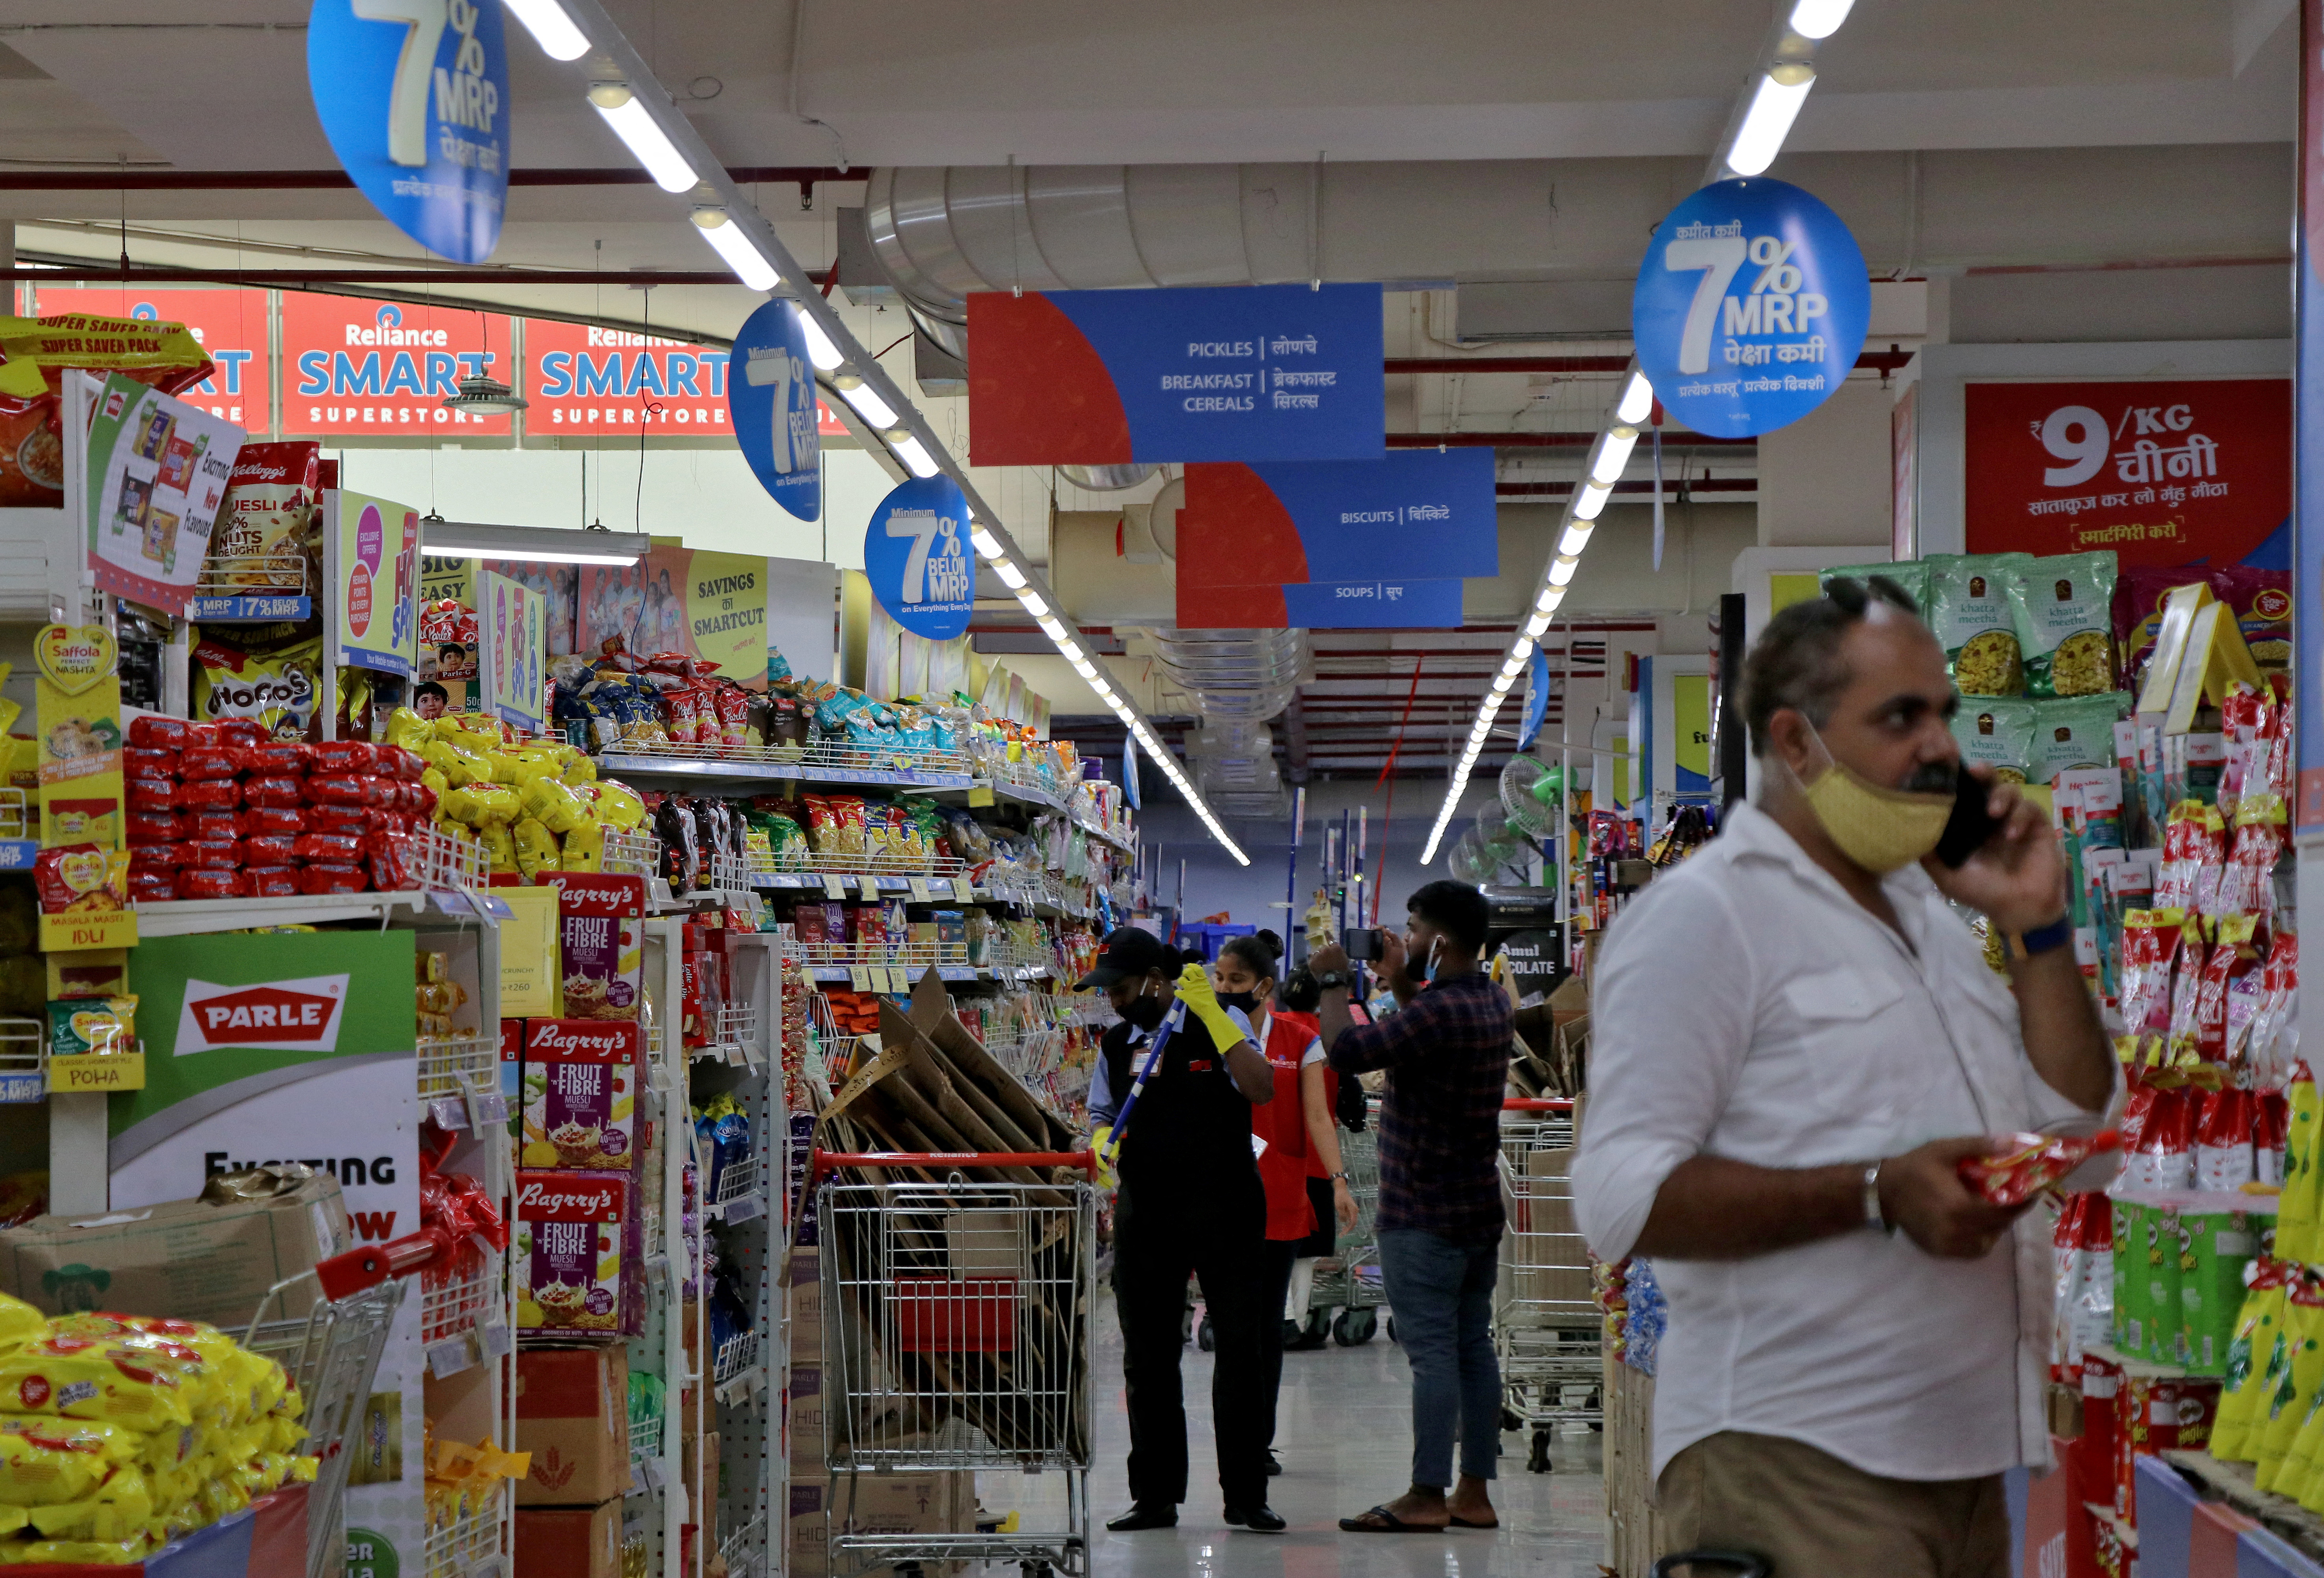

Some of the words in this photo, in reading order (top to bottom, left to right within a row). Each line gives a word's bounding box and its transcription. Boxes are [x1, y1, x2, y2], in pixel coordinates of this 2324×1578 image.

[435, 67, 498, 133] MRP
[1676, 221, 1712, 239] कमीत
[1715, 219, 1743, 238] कमी
[1724, 293, 1828, 336] MRP
[37, 317, 86, 330] SUPER
[346, 324, 447, 346] Reliance
[40, 338, 82, 353] SUPER
[85, 338, 125, 353] SAVER
[128, 338, 161, 353] PACK
[1188, 341, 1254, 357] PICKLES
[1271, 334, 1318, 355] लोणचे
[1724, 338, 1773, 366] पेक्षा
[1777, 335, 1827, 363] कमी
[748, 345, 787, 360] Minimum
[298, 350, 495, 396] SMART
[541, 351, 730, 396] SMART
[1162, 373, 1254, 390] BREAKFAST
[1184, 396, 1255, 412] CEREALS
[1273, 390, 1320, 409] सिरल्स
[552, 408, 725, 424] SUPERSTORE
[2115, 433, 2219, 484] चीनी
[232, 462, 288, 480] Kellogg's
[203, 486, 219, 510] New
[2101, 492, 2129, 507] कर
[2134, 486, 2155, 505] लो
[2191, 481, 2229, 499] मीठा
[891, 507, 935, 518] Minimum
[1341, 511, 1395, 524] BISCUITS
[218, 530, 263, 550] NUTS
[360, 531, 379, 542] EXCLUSIVE
[362, 544, 377, 555] OFFERS
[927, 557, 966, 577] BELOW
[353, 574, 368, 585] REWARD
[698, 572, 755, 599] SAVINGS
[353, 587, 366, 597] POINTS
[929, 575, 969, 602] MRP
[1336, 587, 1374, 598] SOUPS
[1386, 587, 1403, 600] सूप
[203, 600, 232, 611] MRP
[271, 605, 300, 616] MRP
[722, 598, 734, 611] का
[1960, 602, 1995, 614] khatta
[2048, 606, 2084, 618] khatta
[350, 612, 369, 624] PURCHASE
[694, 607, 764, 637] SMARTCUT
[1958, 613, 1997, 624] meetha
[2048, 615, 2088, 627] meetha
[52, 645, 100, 657] Saffola
[55, 666, 96, 675] NASHTA
[442, 669, 471, 678] Parle-G
[1971, 740, 2004, 751] khatta
[1970, 748, 2008, 760] meetha
[547, 878, 633, 911] Bagrry's
[51, 917, 90, 926] MASALA
[566, 917, 610, 933] FRUIT
[72, 929, 104, 945] IDLI
[566, 933, 608, 948] FIBRE
[572, 948, 598, 957] MUESLI
[1499, 942, 1540, 957] Amul
[1481, 961, 1556, 974] CCOLATE
[854, 972, 863, 981] 69
[893, 972, 901, 982] 10
[205, 1004, 321, 1029] PARLE
[530, 1025, 626, 1057] Bagrry's
[70, 1069, 120, 1086] POHA
[558, 1064, 603, 1080] FRUIT
[558, 1079, 601, 1096] FIBRE
[843, 1070, 874, 1099] CAPITAL
[564, 1096, 591, 1104] MUESLI
[518, 1182, 612, 1215] Bagrry's
[543, 1223, 588, 1239] FRUIT
[543, 1238, 587, 1255] FIBRE
[550, 1254, 576, 1264] MUESLI
[791, 1491, 818, 1500] PARLE
